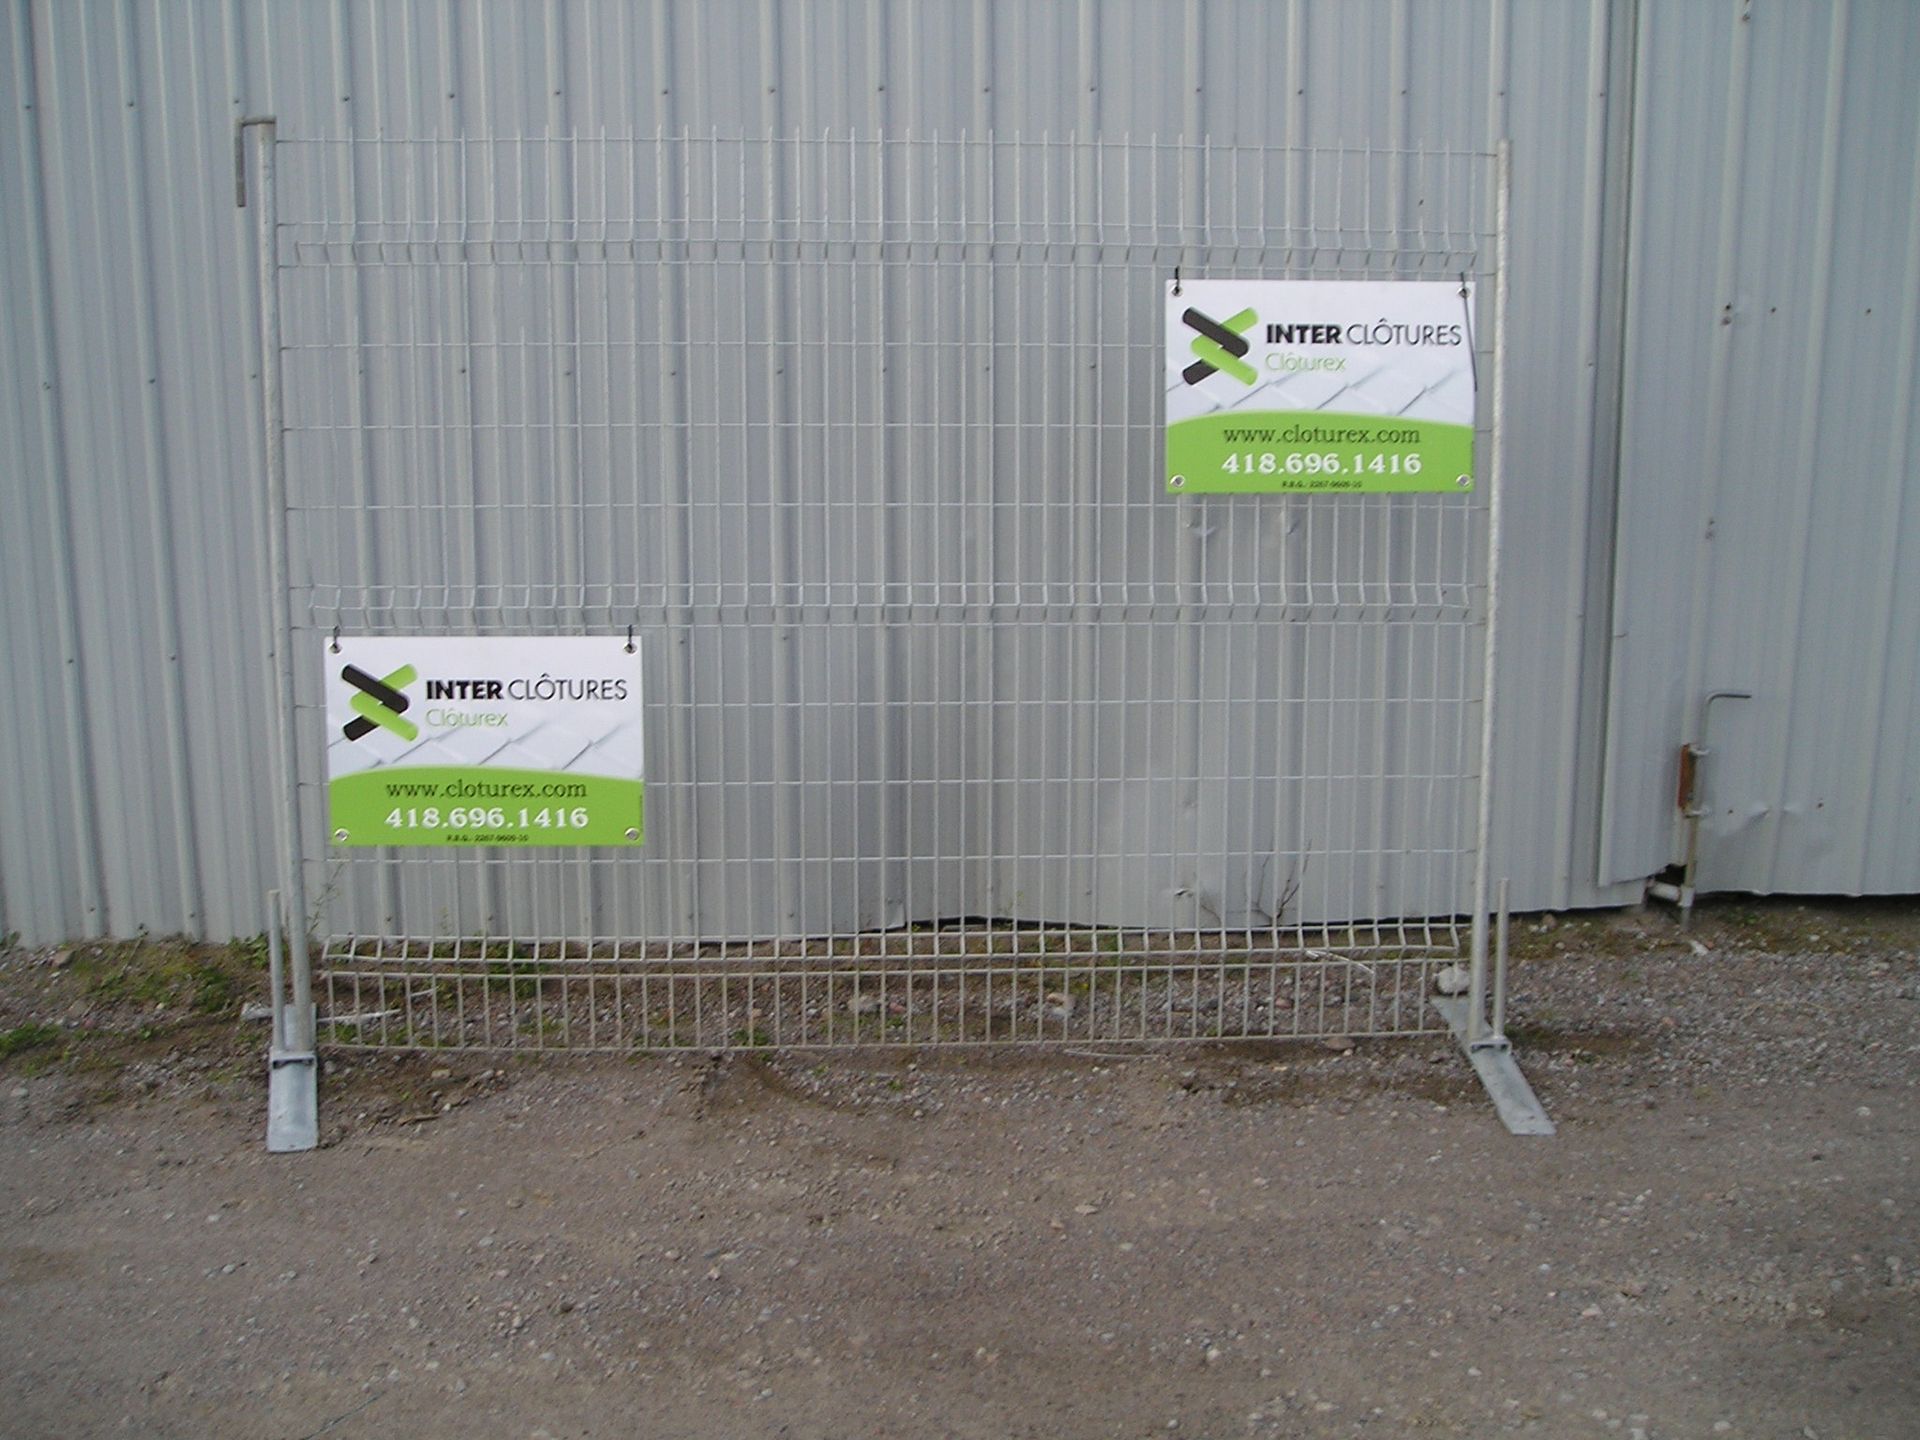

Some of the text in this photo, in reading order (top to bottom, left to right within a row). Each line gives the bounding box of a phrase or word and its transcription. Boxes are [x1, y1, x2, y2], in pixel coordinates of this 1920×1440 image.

[1266, 317, 1462, 346] INTER CLÔTURES
[1264, 351, 1347, 372] Clôturex
[1223, 424, 1421, 444] www.cloturex.com
[1221, 452, 1422, 475] 418.696.1416
[426, 672, 628, 701] INTER CLÔTURES
[425, 707, 509, 728] Clôturex
[385, 778, 588, 798] www.cloturex.com
[384, 807, 590, 830] 418.696.1416
